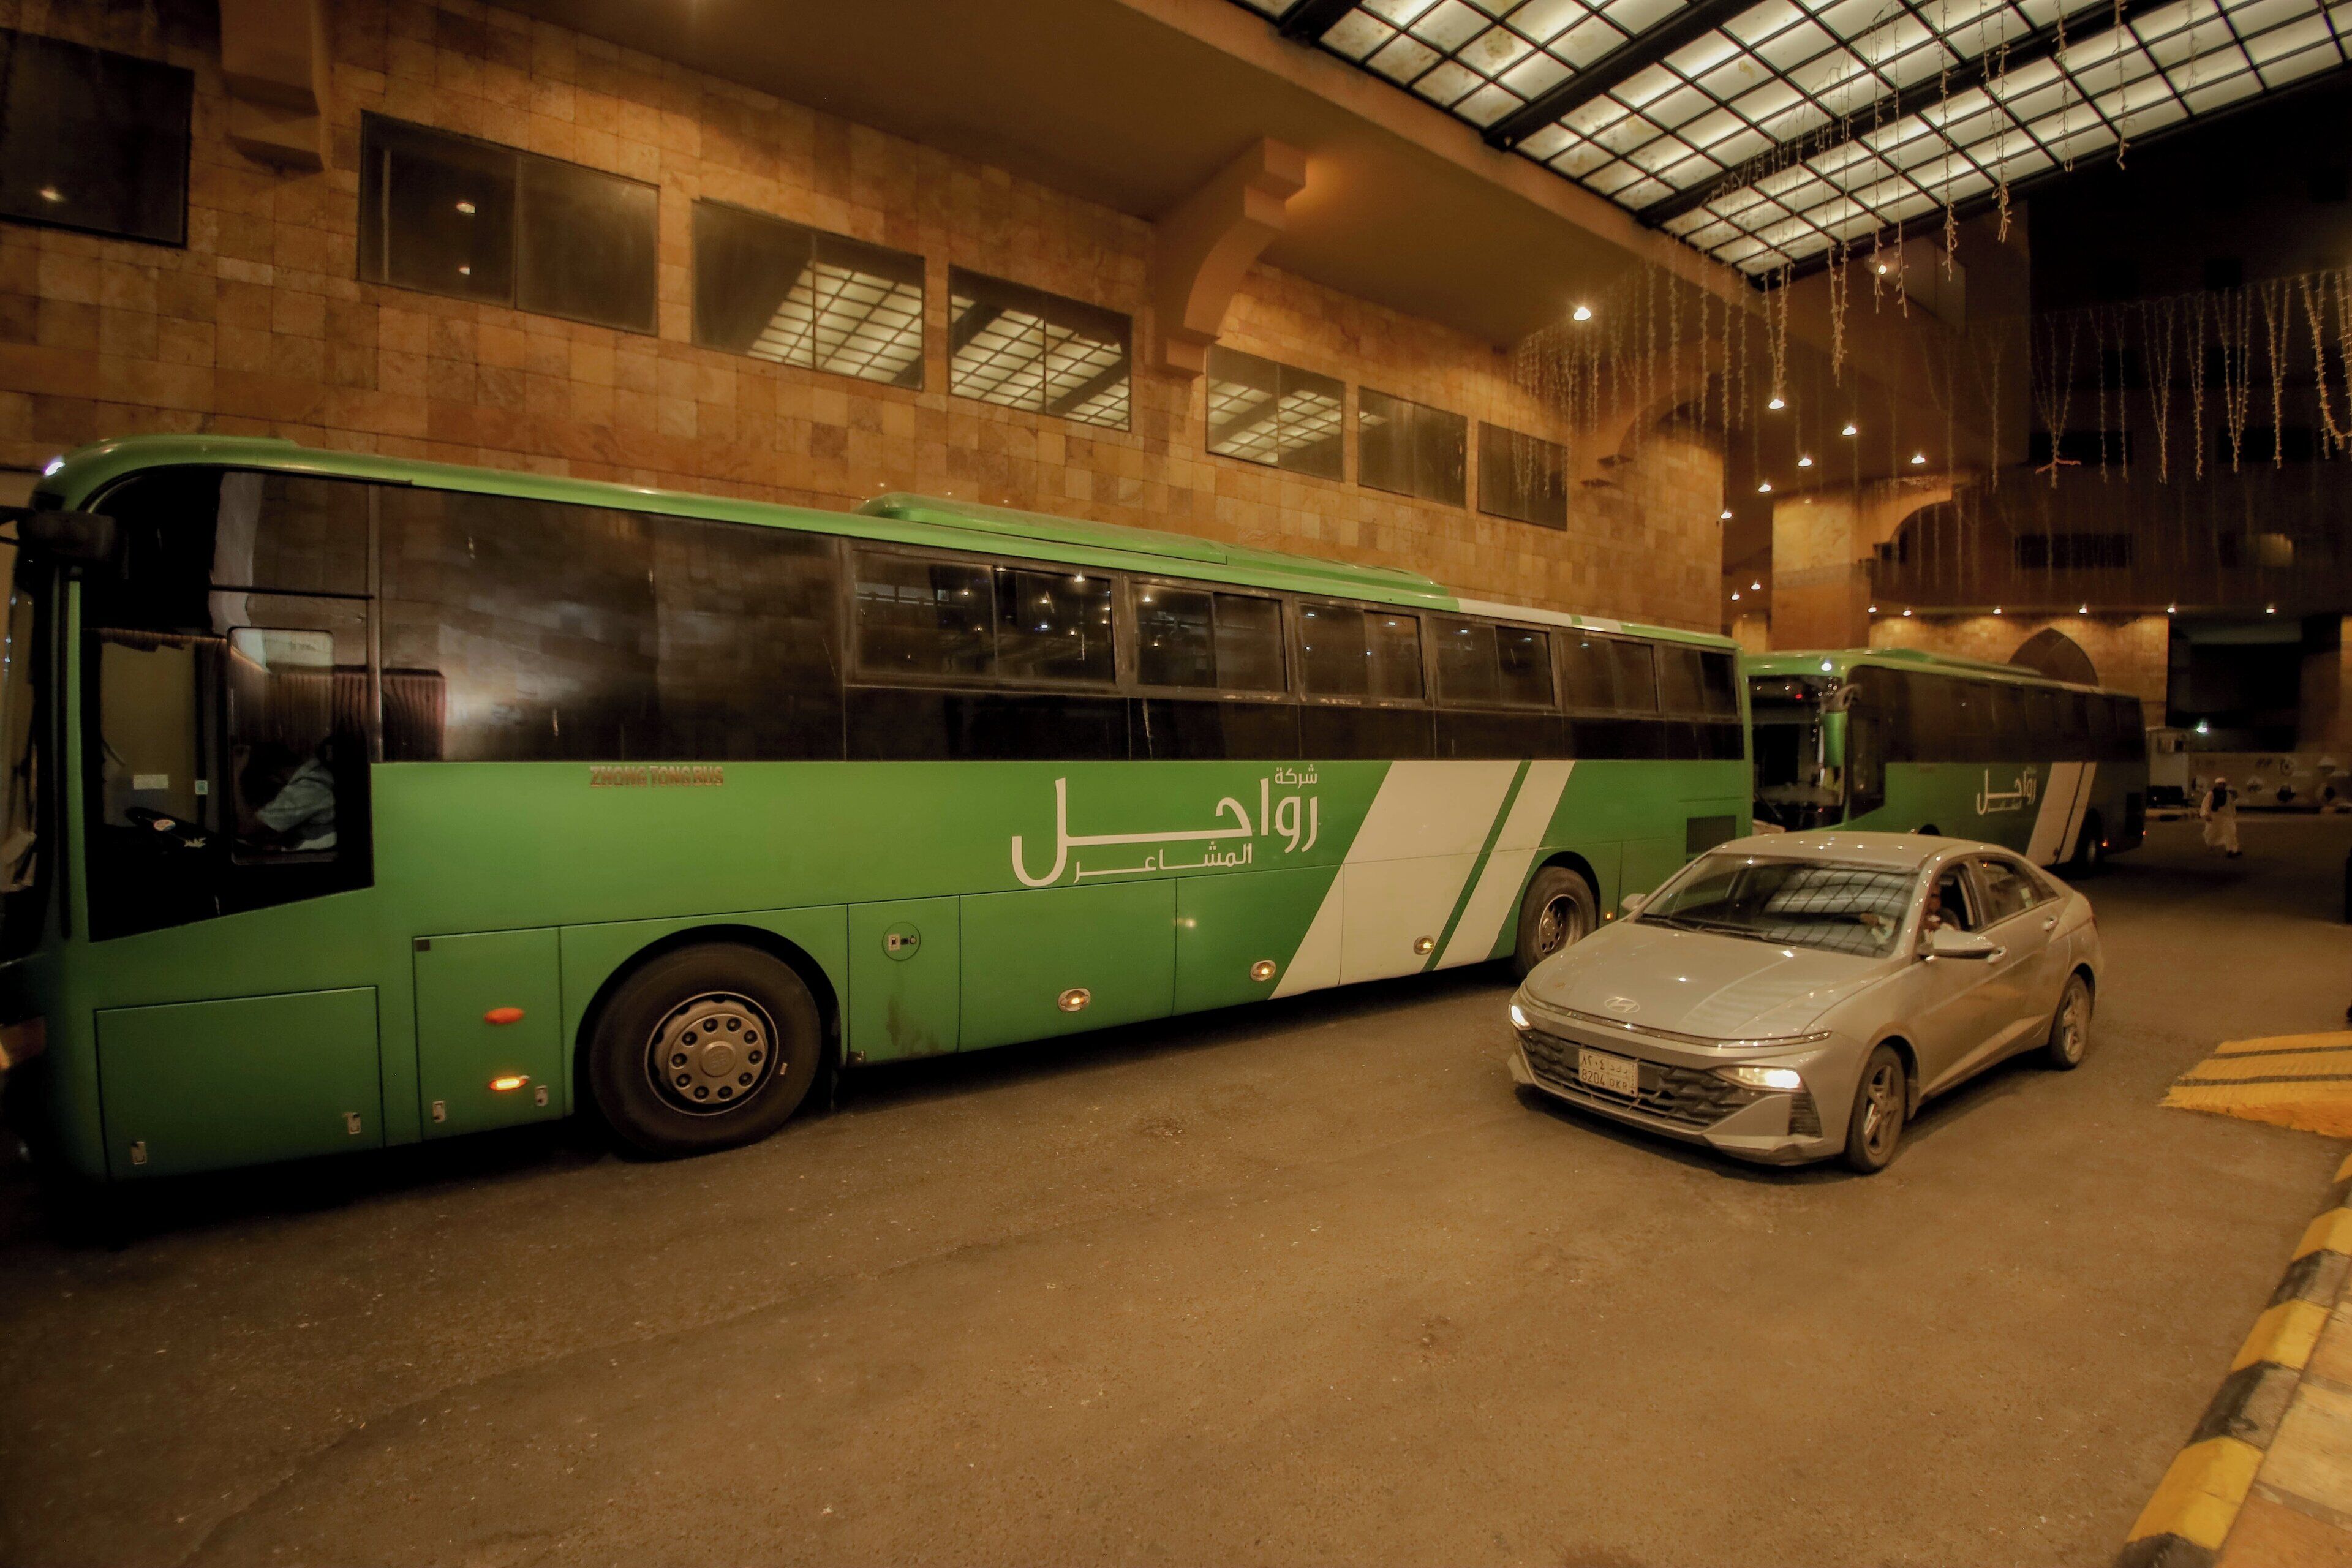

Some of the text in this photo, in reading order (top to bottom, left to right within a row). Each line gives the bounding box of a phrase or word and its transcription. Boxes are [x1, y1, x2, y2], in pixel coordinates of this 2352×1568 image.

[590, 766, 723, 788] ZHONG TONG BUS
[1275, 764, 1317, 789] شركة
[1011, 777, 1319, 887] رواحل
[1073, 840, 1253, 884] المشاعر
[1581, 1068, 1605, 1085] 8204
